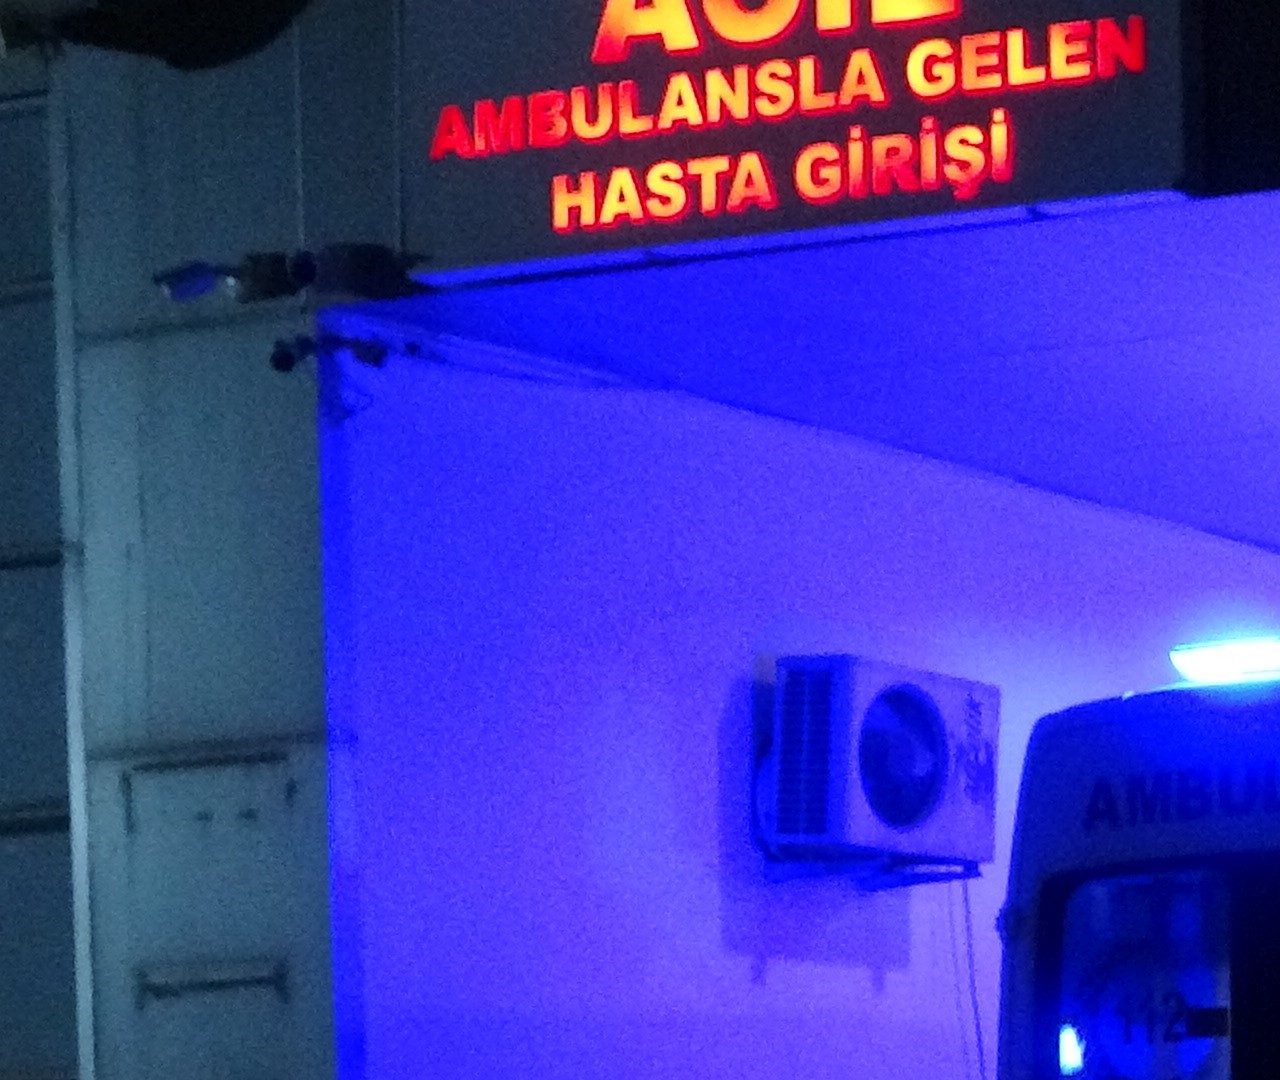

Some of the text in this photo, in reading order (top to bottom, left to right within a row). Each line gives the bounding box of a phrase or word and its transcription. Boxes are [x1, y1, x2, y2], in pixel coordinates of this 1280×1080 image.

[431, 50, 885, 160] AMBULANSLA
[905, 15, 1146, 99] GELEN
[552, 107, 1014, 232] HASTA GİRİŞİ
